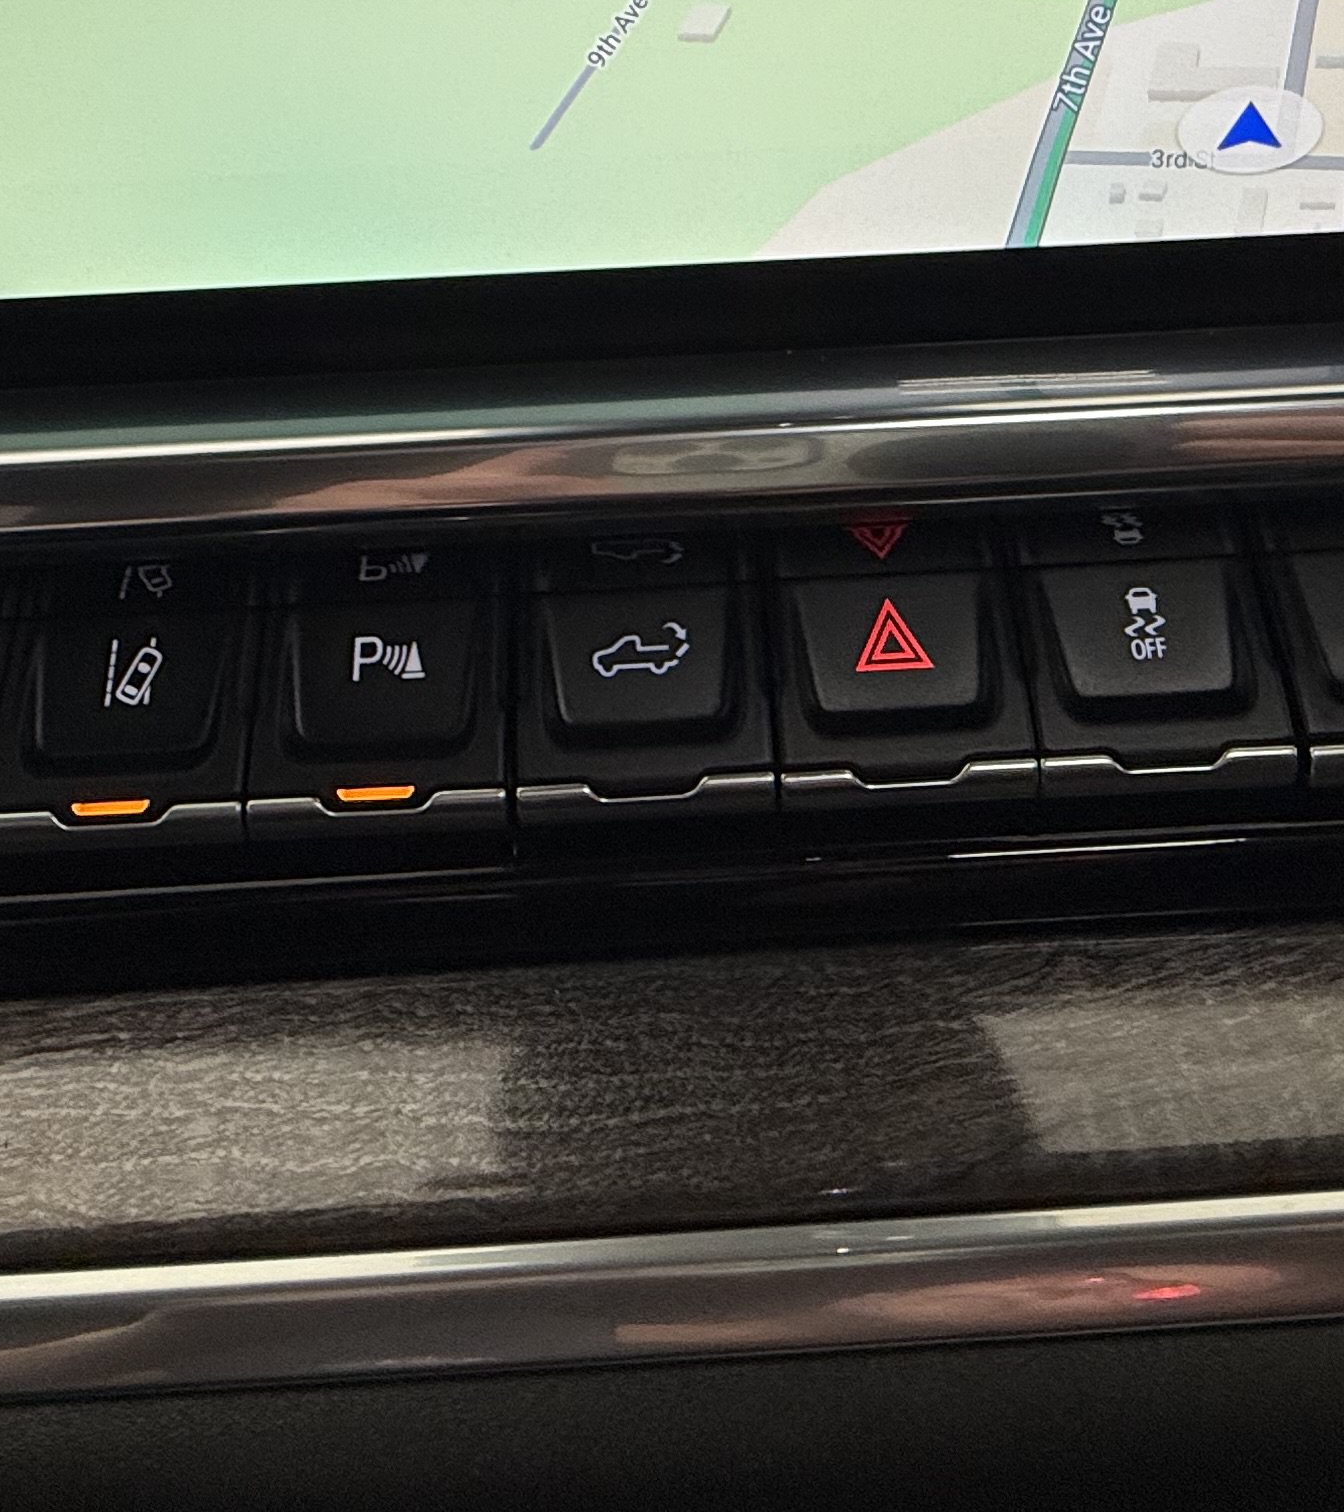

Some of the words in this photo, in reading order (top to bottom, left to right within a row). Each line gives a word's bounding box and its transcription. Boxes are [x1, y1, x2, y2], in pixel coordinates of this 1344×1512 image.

[587, 34, 622, 68] 9th
[1052, 64, 1091, 112] 7th
[1074, 5, 1111, 61] Ave
[1151, 148, 1188, 169] 3rd
[1130, 637, 1168, 661] OFF
